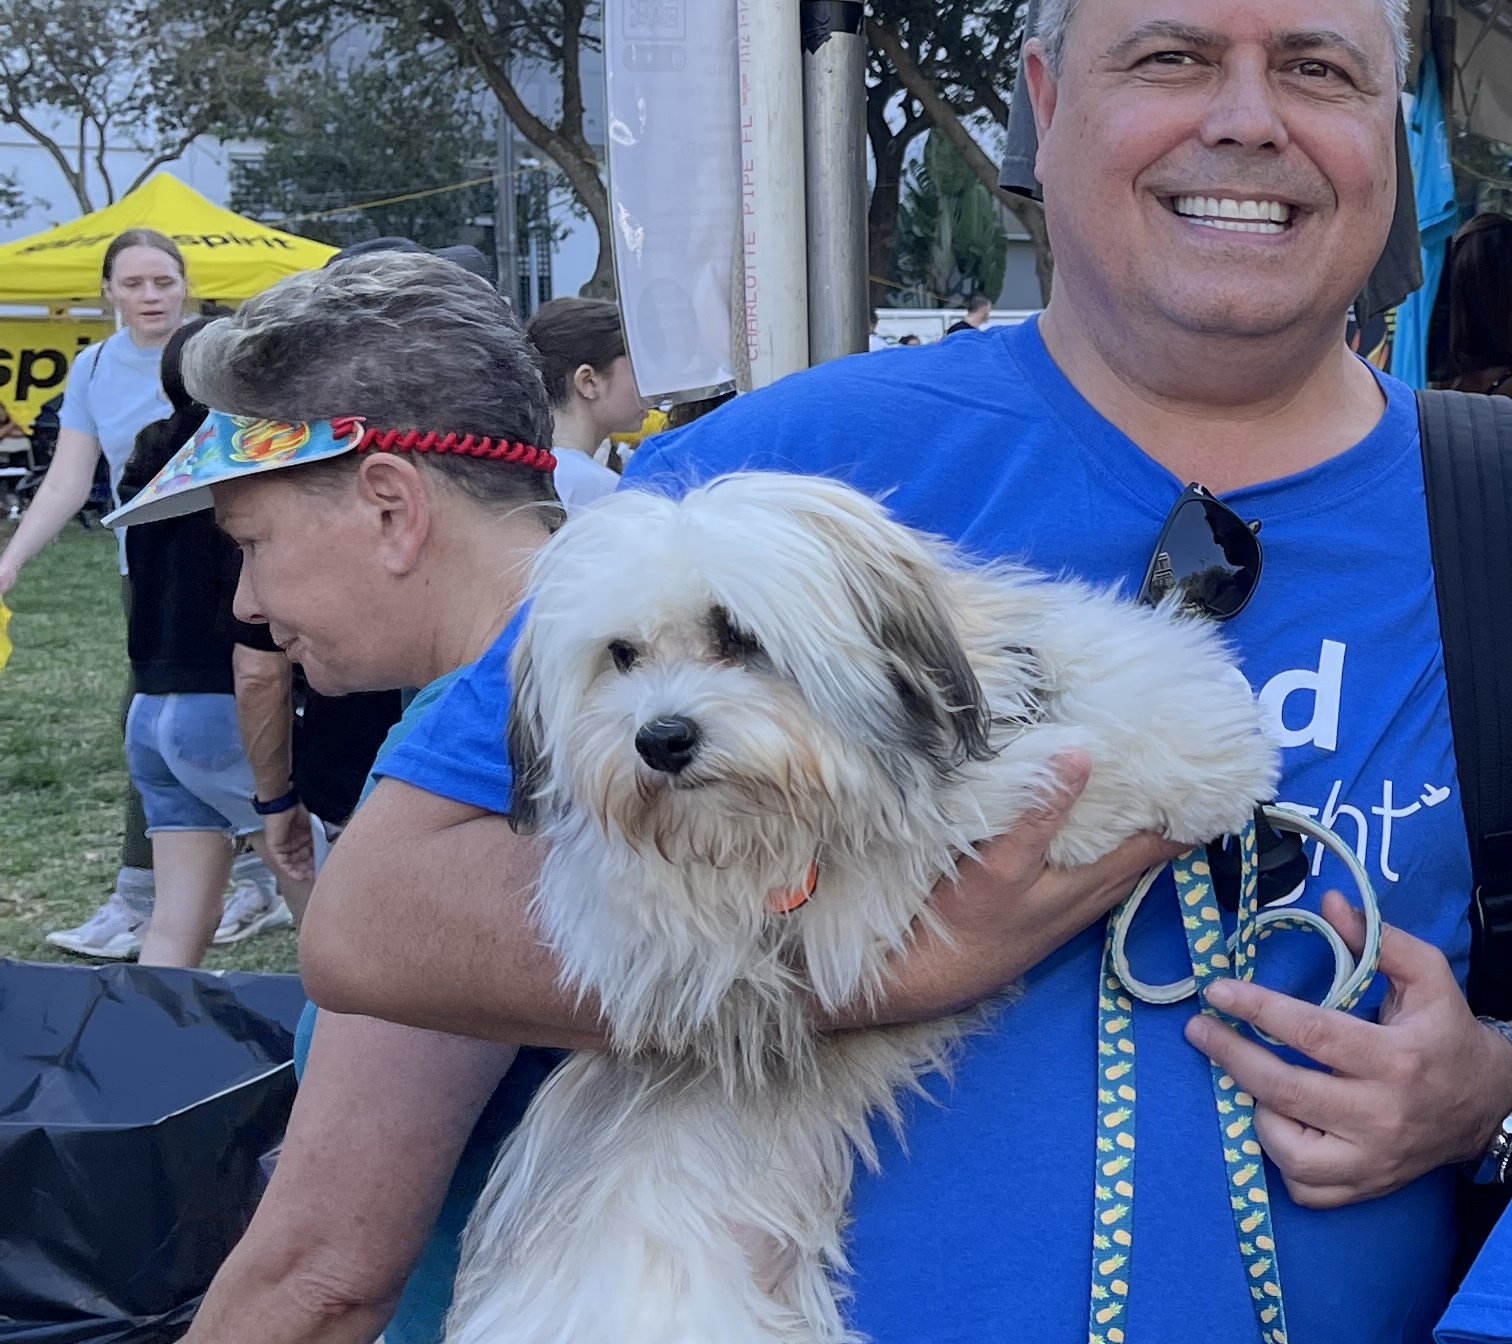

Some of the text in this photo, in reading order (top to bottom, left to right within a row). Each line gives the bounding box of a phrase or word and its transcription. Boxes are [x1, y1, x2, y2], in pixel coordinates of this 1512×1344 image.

[741, 159, 755, 215] PIPE
[171, 229, 298, 252] spirit
[1235, 639, 1346, 751] d
